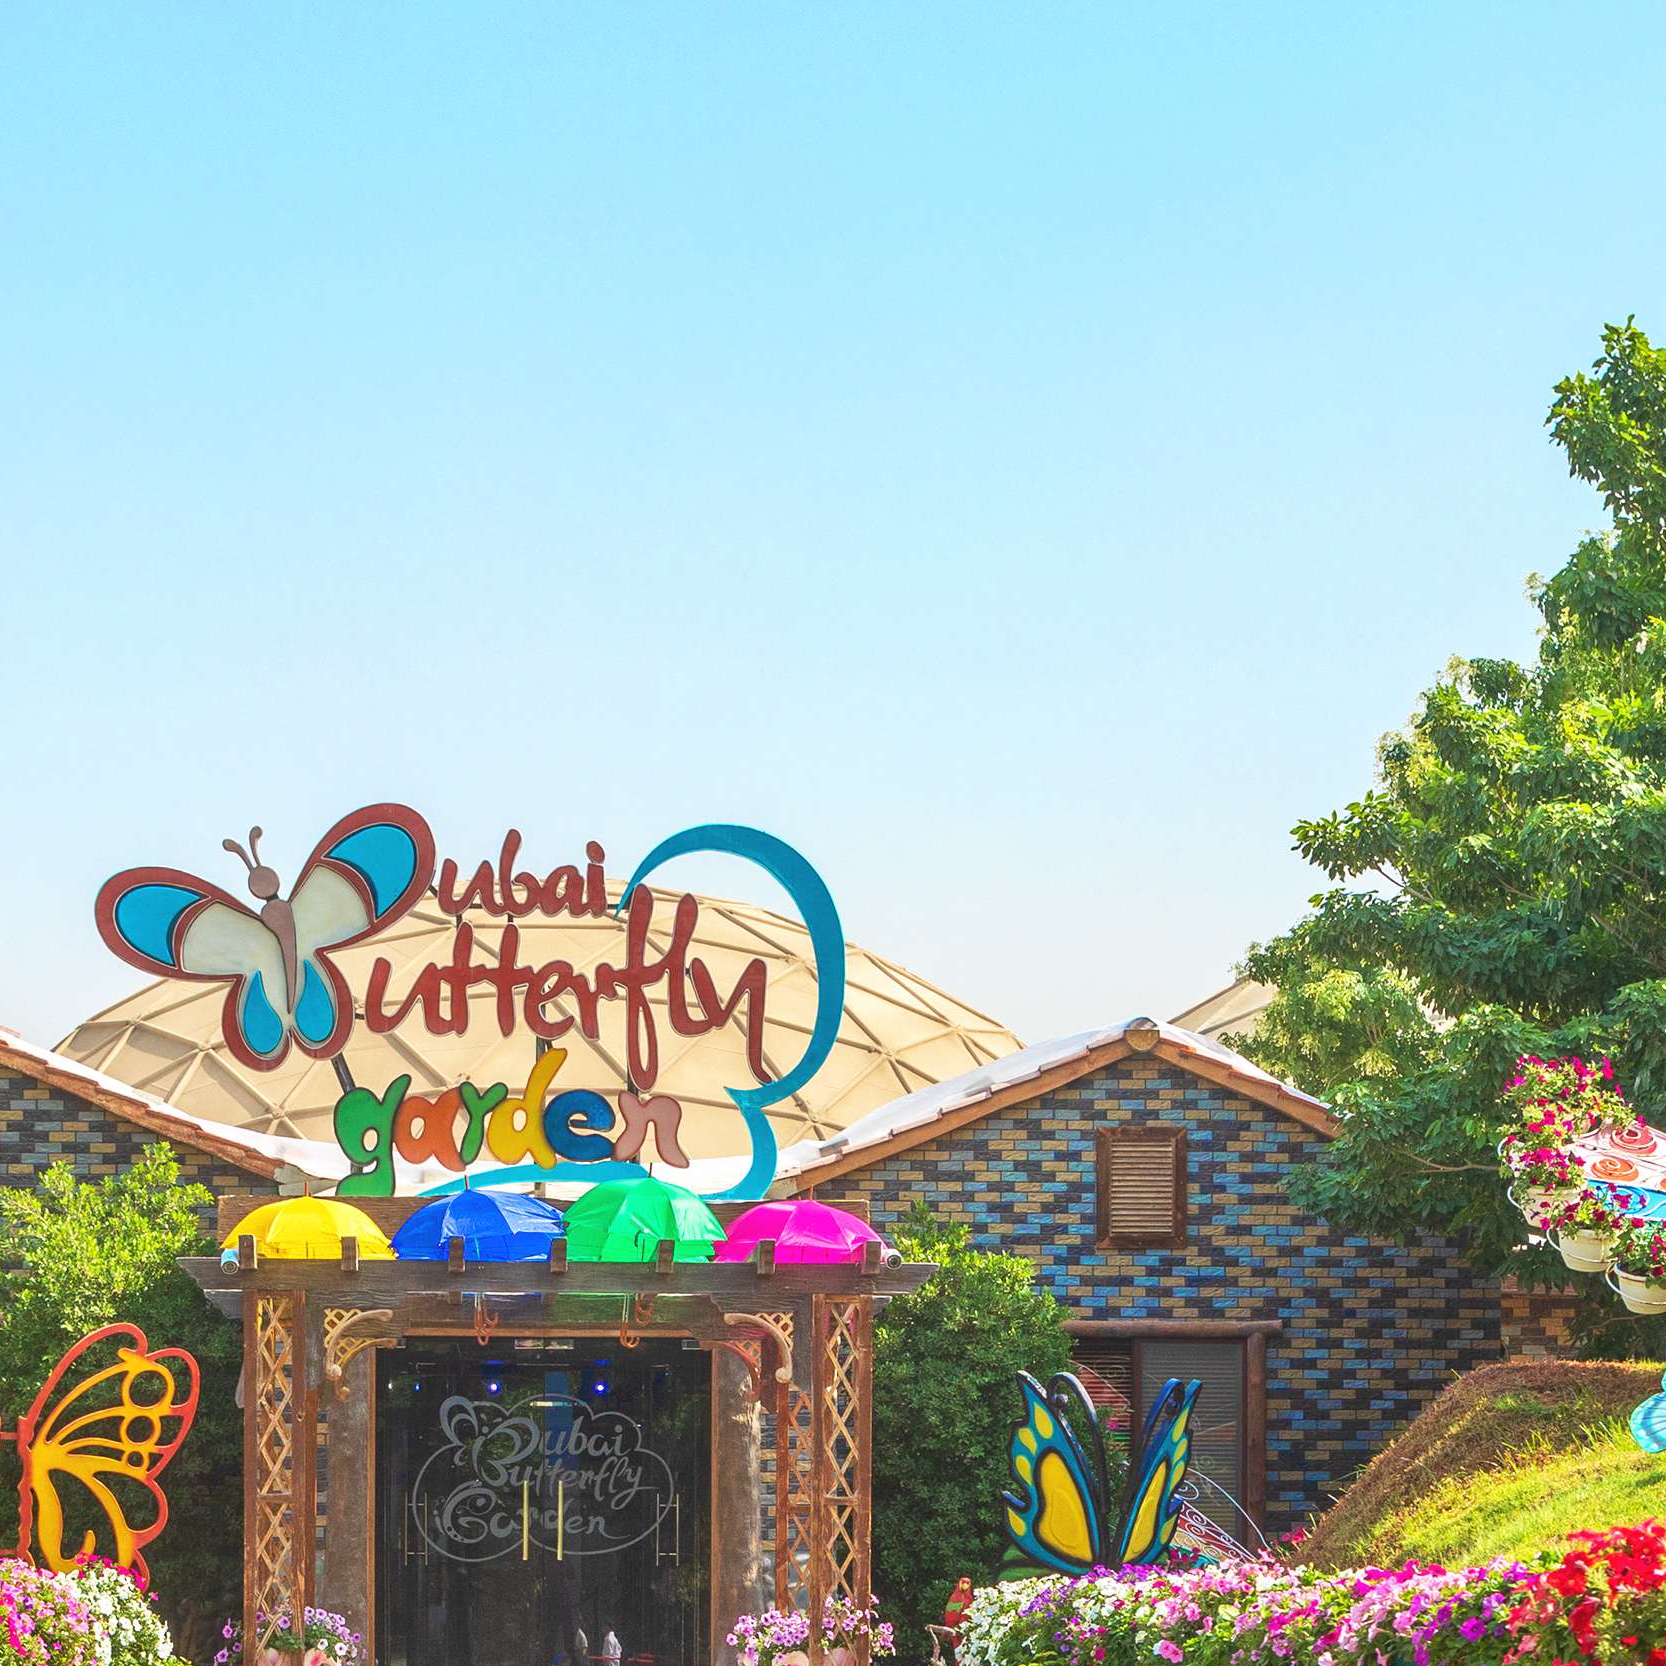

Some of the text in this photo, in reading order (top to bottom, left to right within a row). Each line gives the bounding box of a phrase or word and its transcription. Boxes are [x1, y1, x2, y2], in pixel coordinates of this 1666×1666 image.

[333, 1046, 691, 1197] garden
[481, 1416, 630, 1464] Dubai
[473, 1448, 659, 1510] Butterfly
[443, 1481, 631, 1544] Garden
